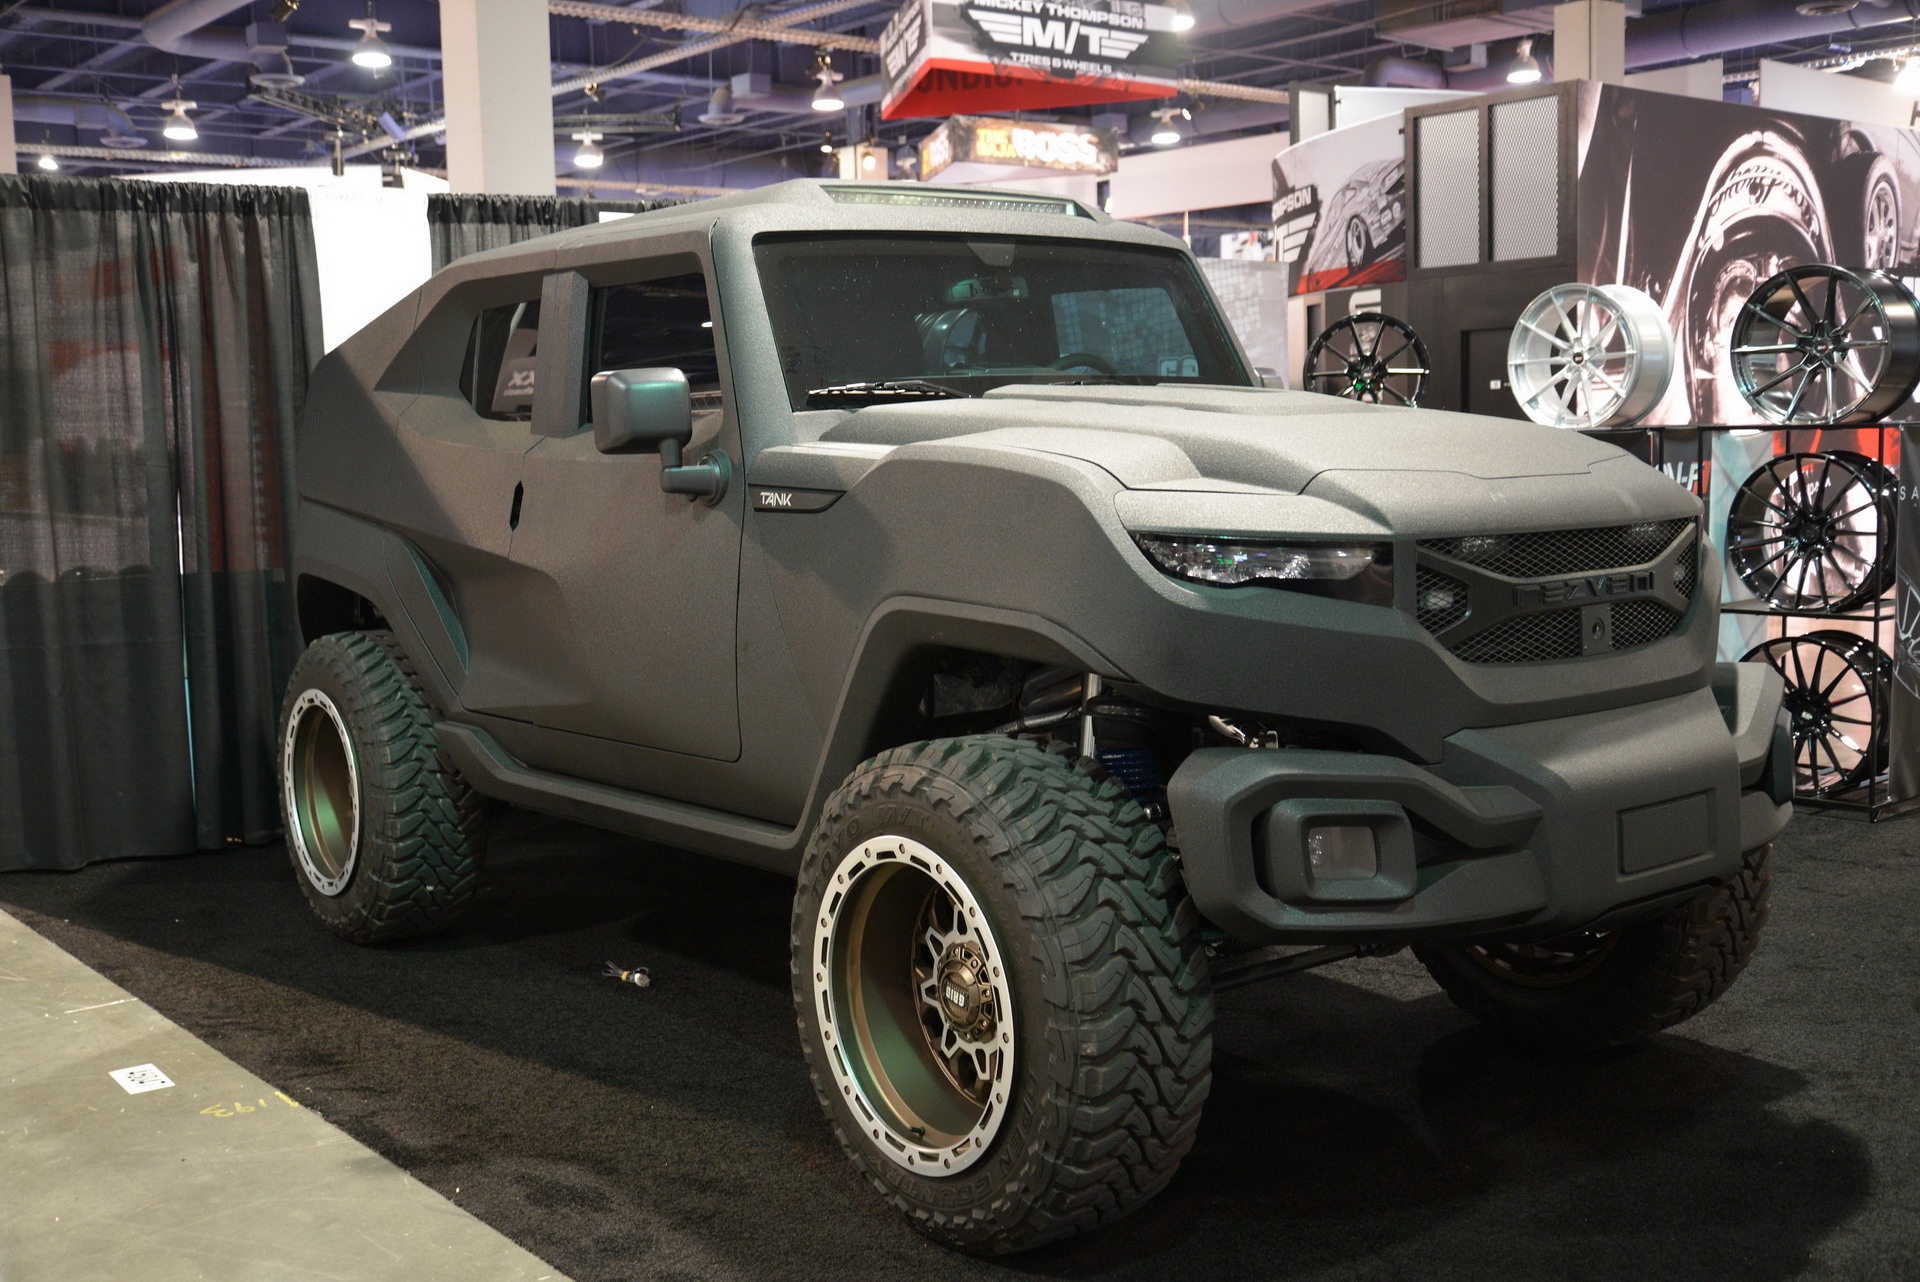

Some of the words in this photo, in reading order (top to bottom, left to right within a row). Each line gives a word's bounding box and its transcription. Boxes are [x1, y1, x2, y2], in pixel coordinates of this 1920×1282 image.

[1046, 4, 1143, 29] THOMPSON
[1022, 16, 1110, 55] M/T
[1010, 52, 1051, 67] TIRES
[1062, 60, 1112, 74] WHEELS
[760, 491, 792, 507] TANK
[945, 985, 965, 1007] GRID
